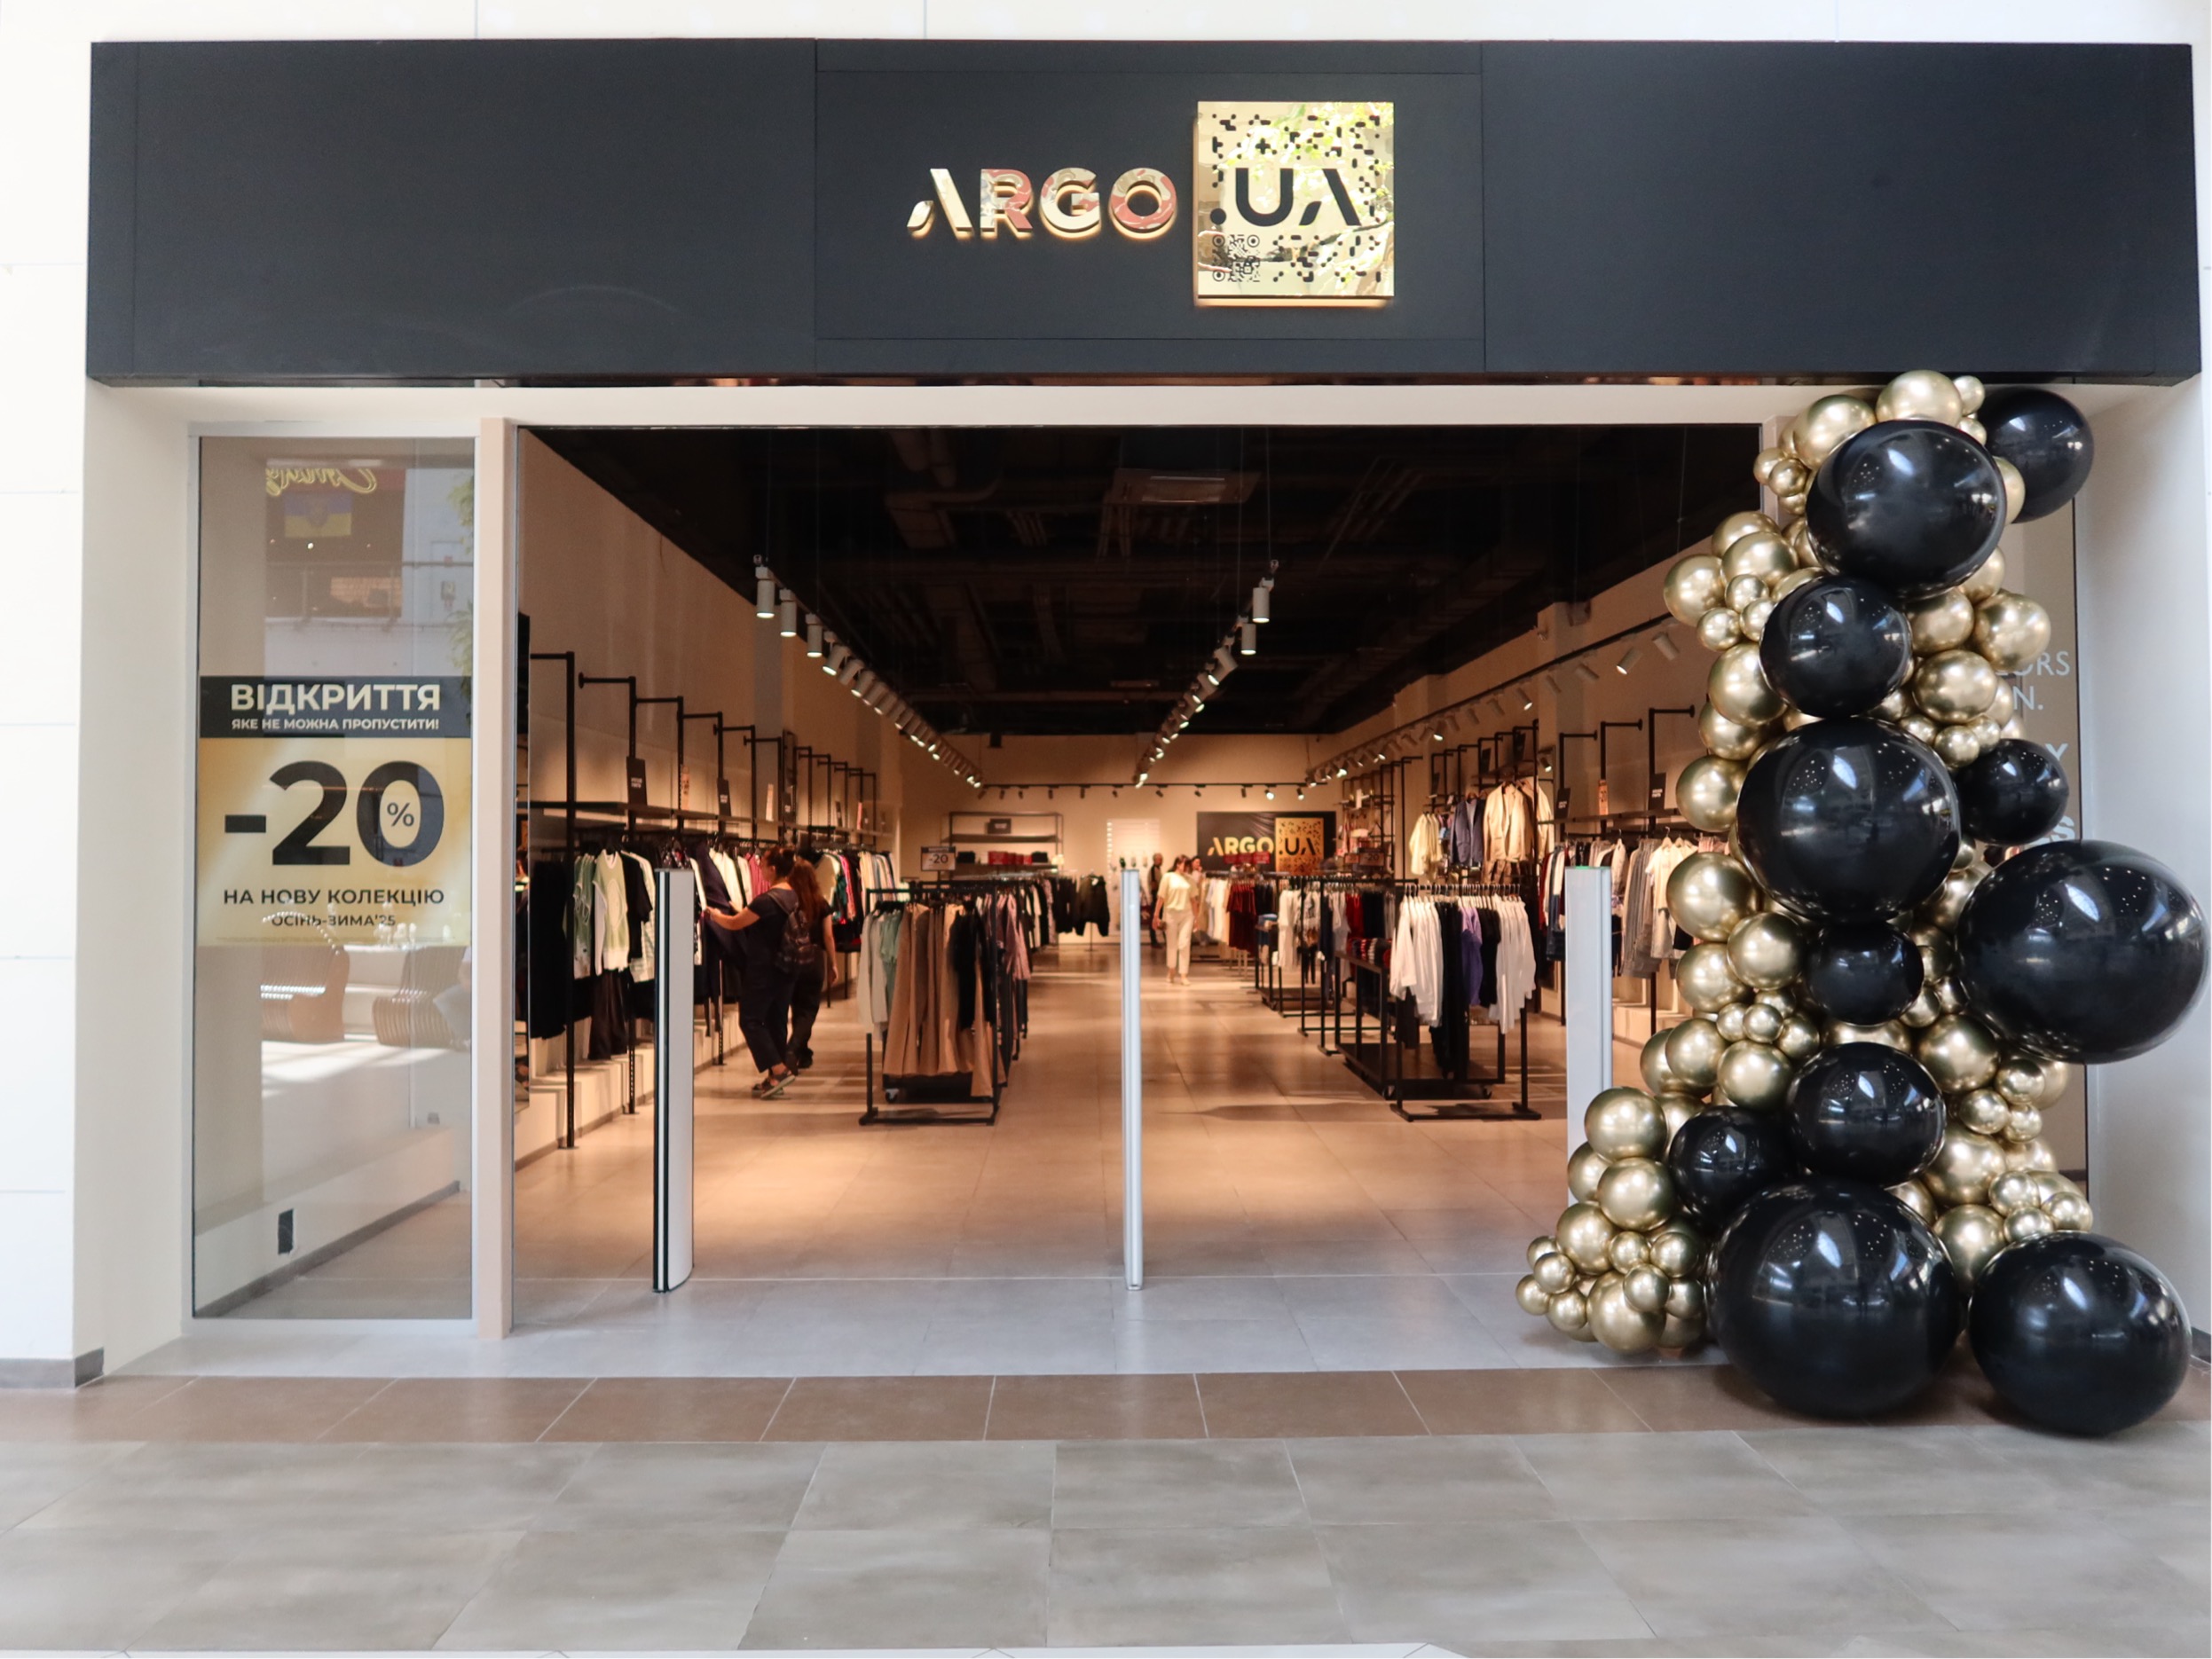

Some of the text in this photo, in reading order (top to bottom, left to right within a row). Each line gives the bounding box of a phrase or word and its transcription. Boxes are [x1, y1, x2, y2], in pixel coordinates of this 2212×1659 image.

[907, 167, 1177, 233] ARGO
[232, 684, 440, 715] ВІДКРИТТЯ
[232, 718, 439, 731] ЯКЕ НЕ МОЖНА ПРОПУСТИТИ!
[224, 888, 445, 907] НА НОВУ КОЛЕКЦІЮ
